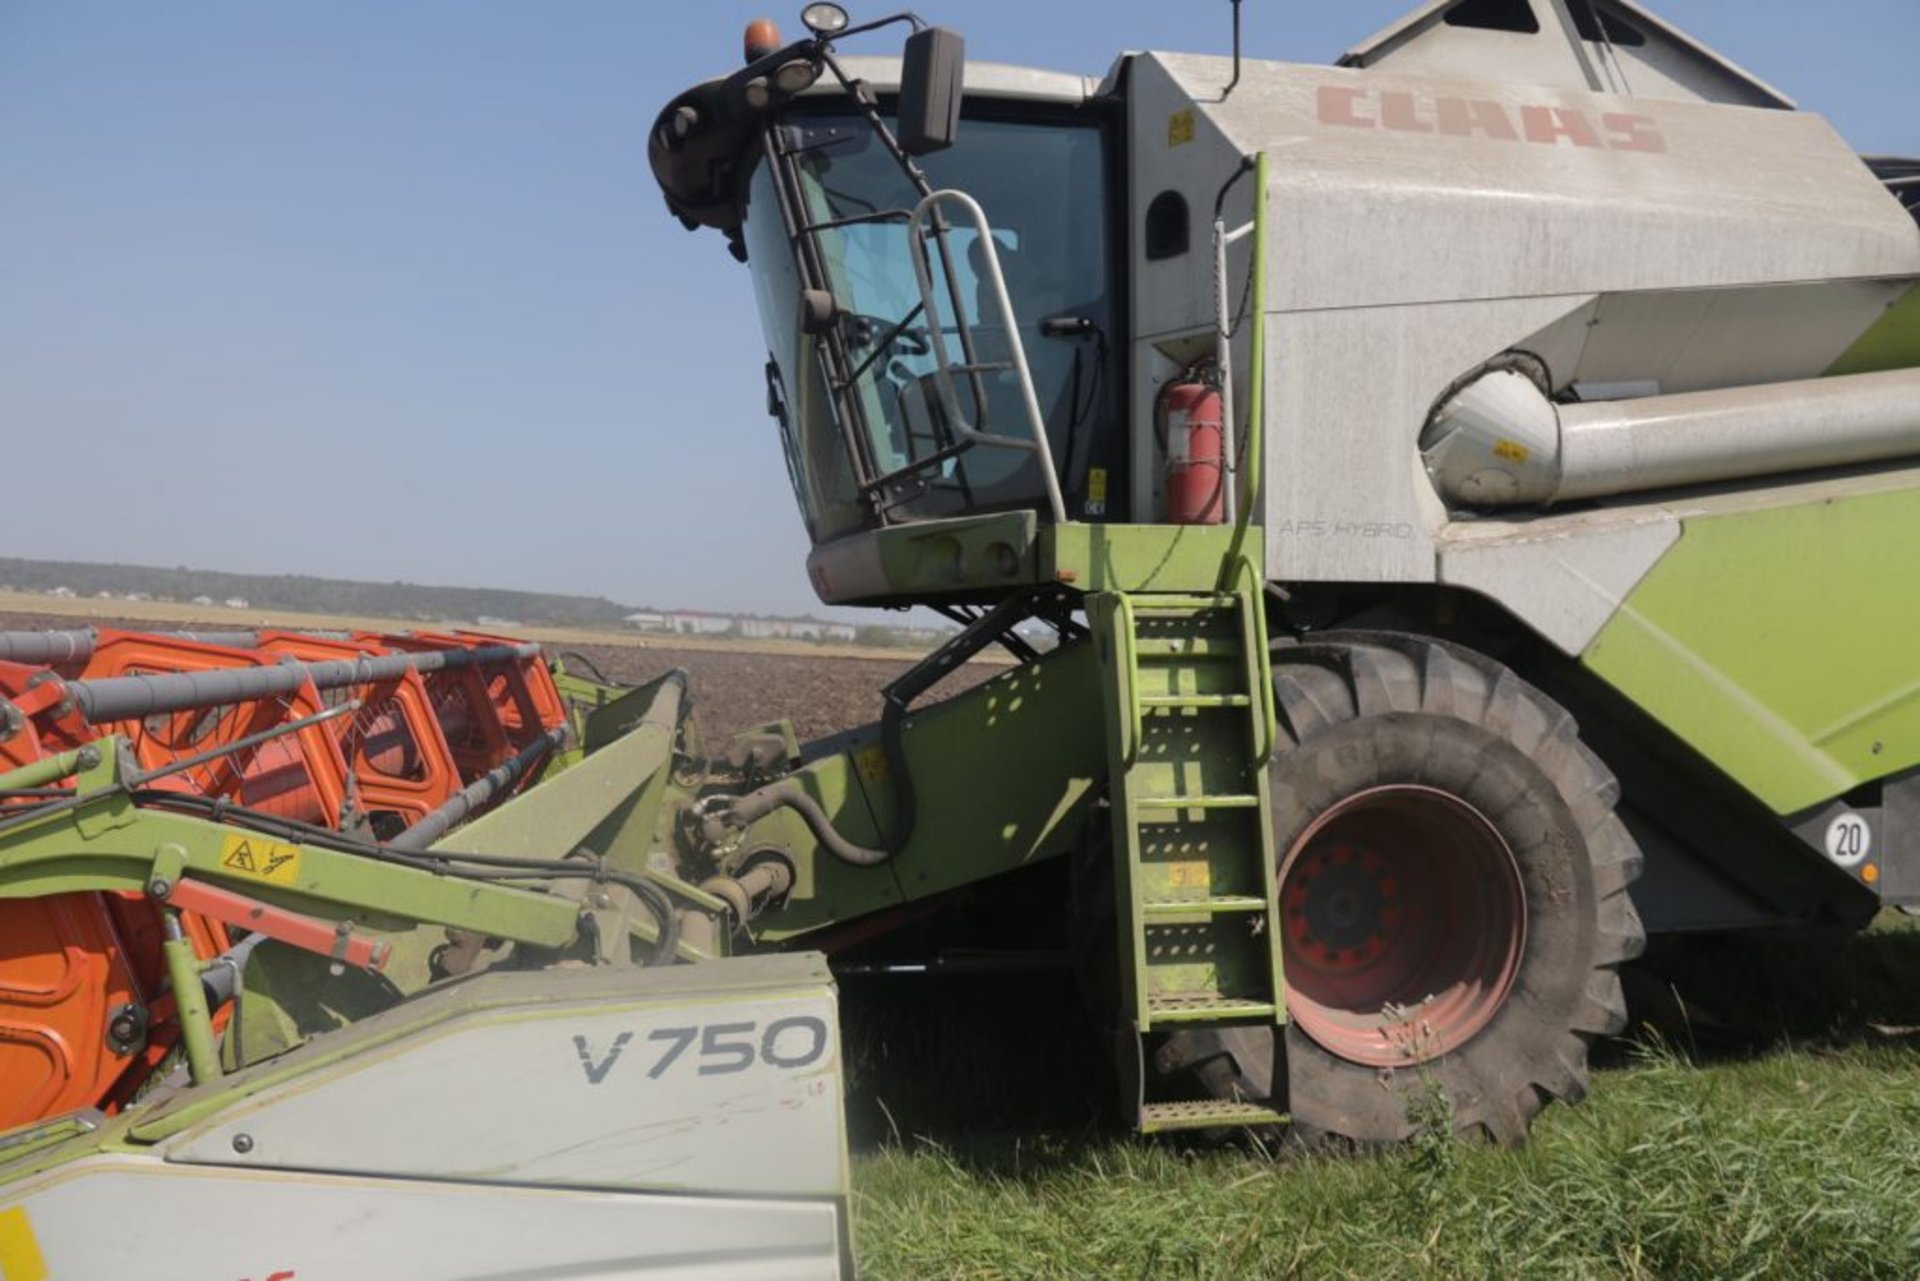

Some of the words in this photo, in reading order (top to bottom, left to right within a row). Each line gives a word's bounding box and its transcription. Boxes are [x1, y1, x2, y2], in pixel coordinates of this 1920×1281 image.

[1317, 86, 1666, 153] CLAAS
[1279, 519, 1327, 537] APS
[1835, 823, 1861, 856] 20
[572, 1031, 634, 1084] V
[647, 1016, 828, 1079] 750
